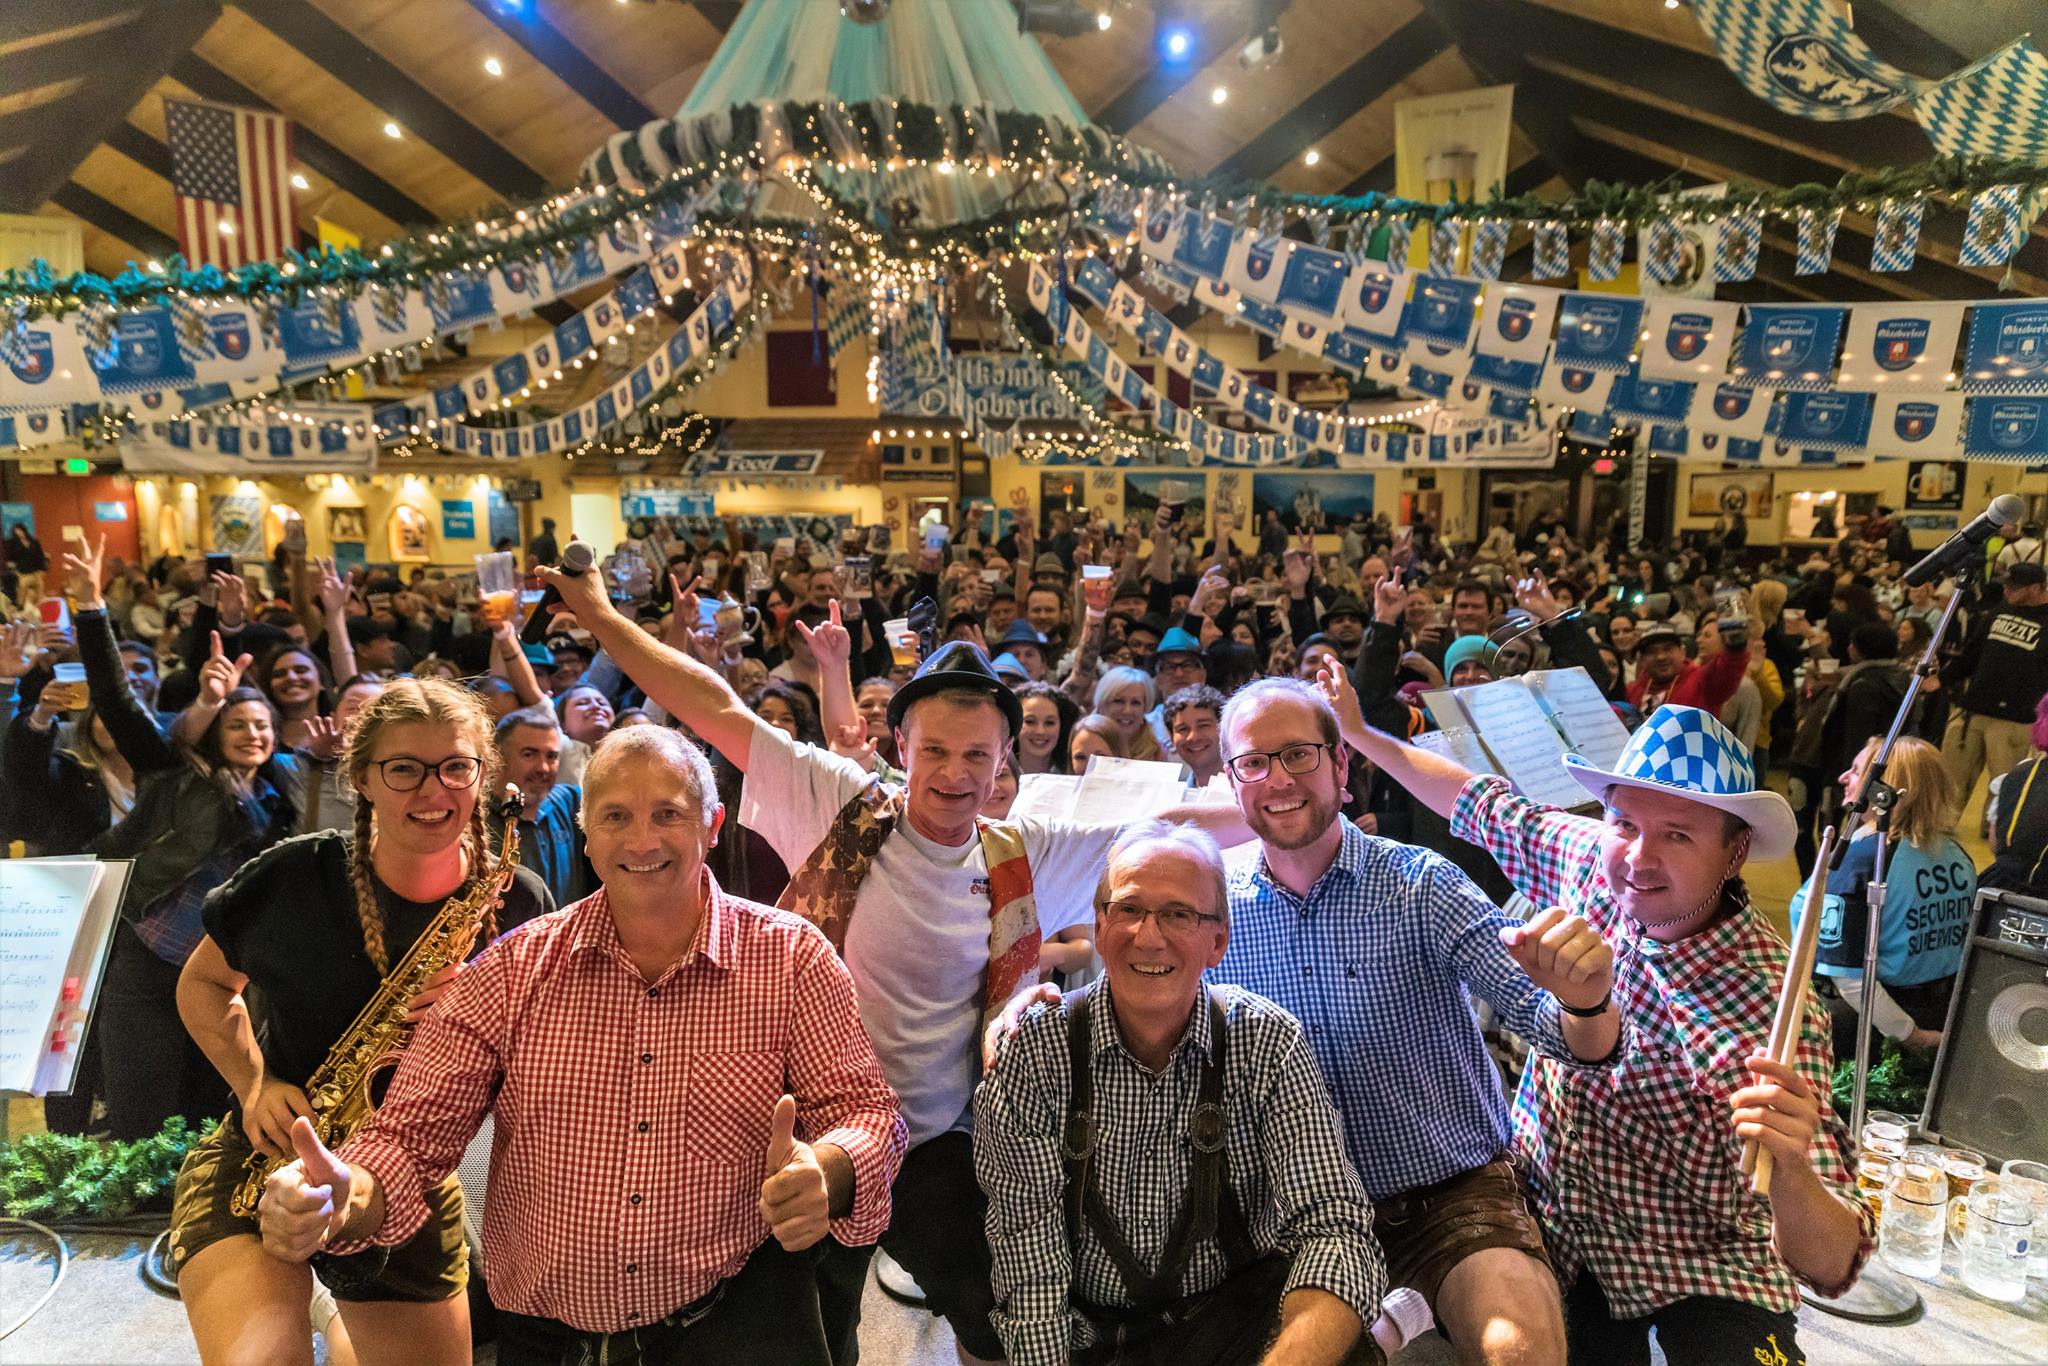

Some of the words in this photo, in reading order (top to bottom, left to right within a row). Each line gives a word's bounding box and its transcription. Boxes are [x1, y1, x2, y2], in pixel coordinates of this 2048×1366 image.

[726, 455, 777, 472] Food
[1990, 618, 2039, 642] GRIZZLY
[1916, 862, 1968, 899] CSC
